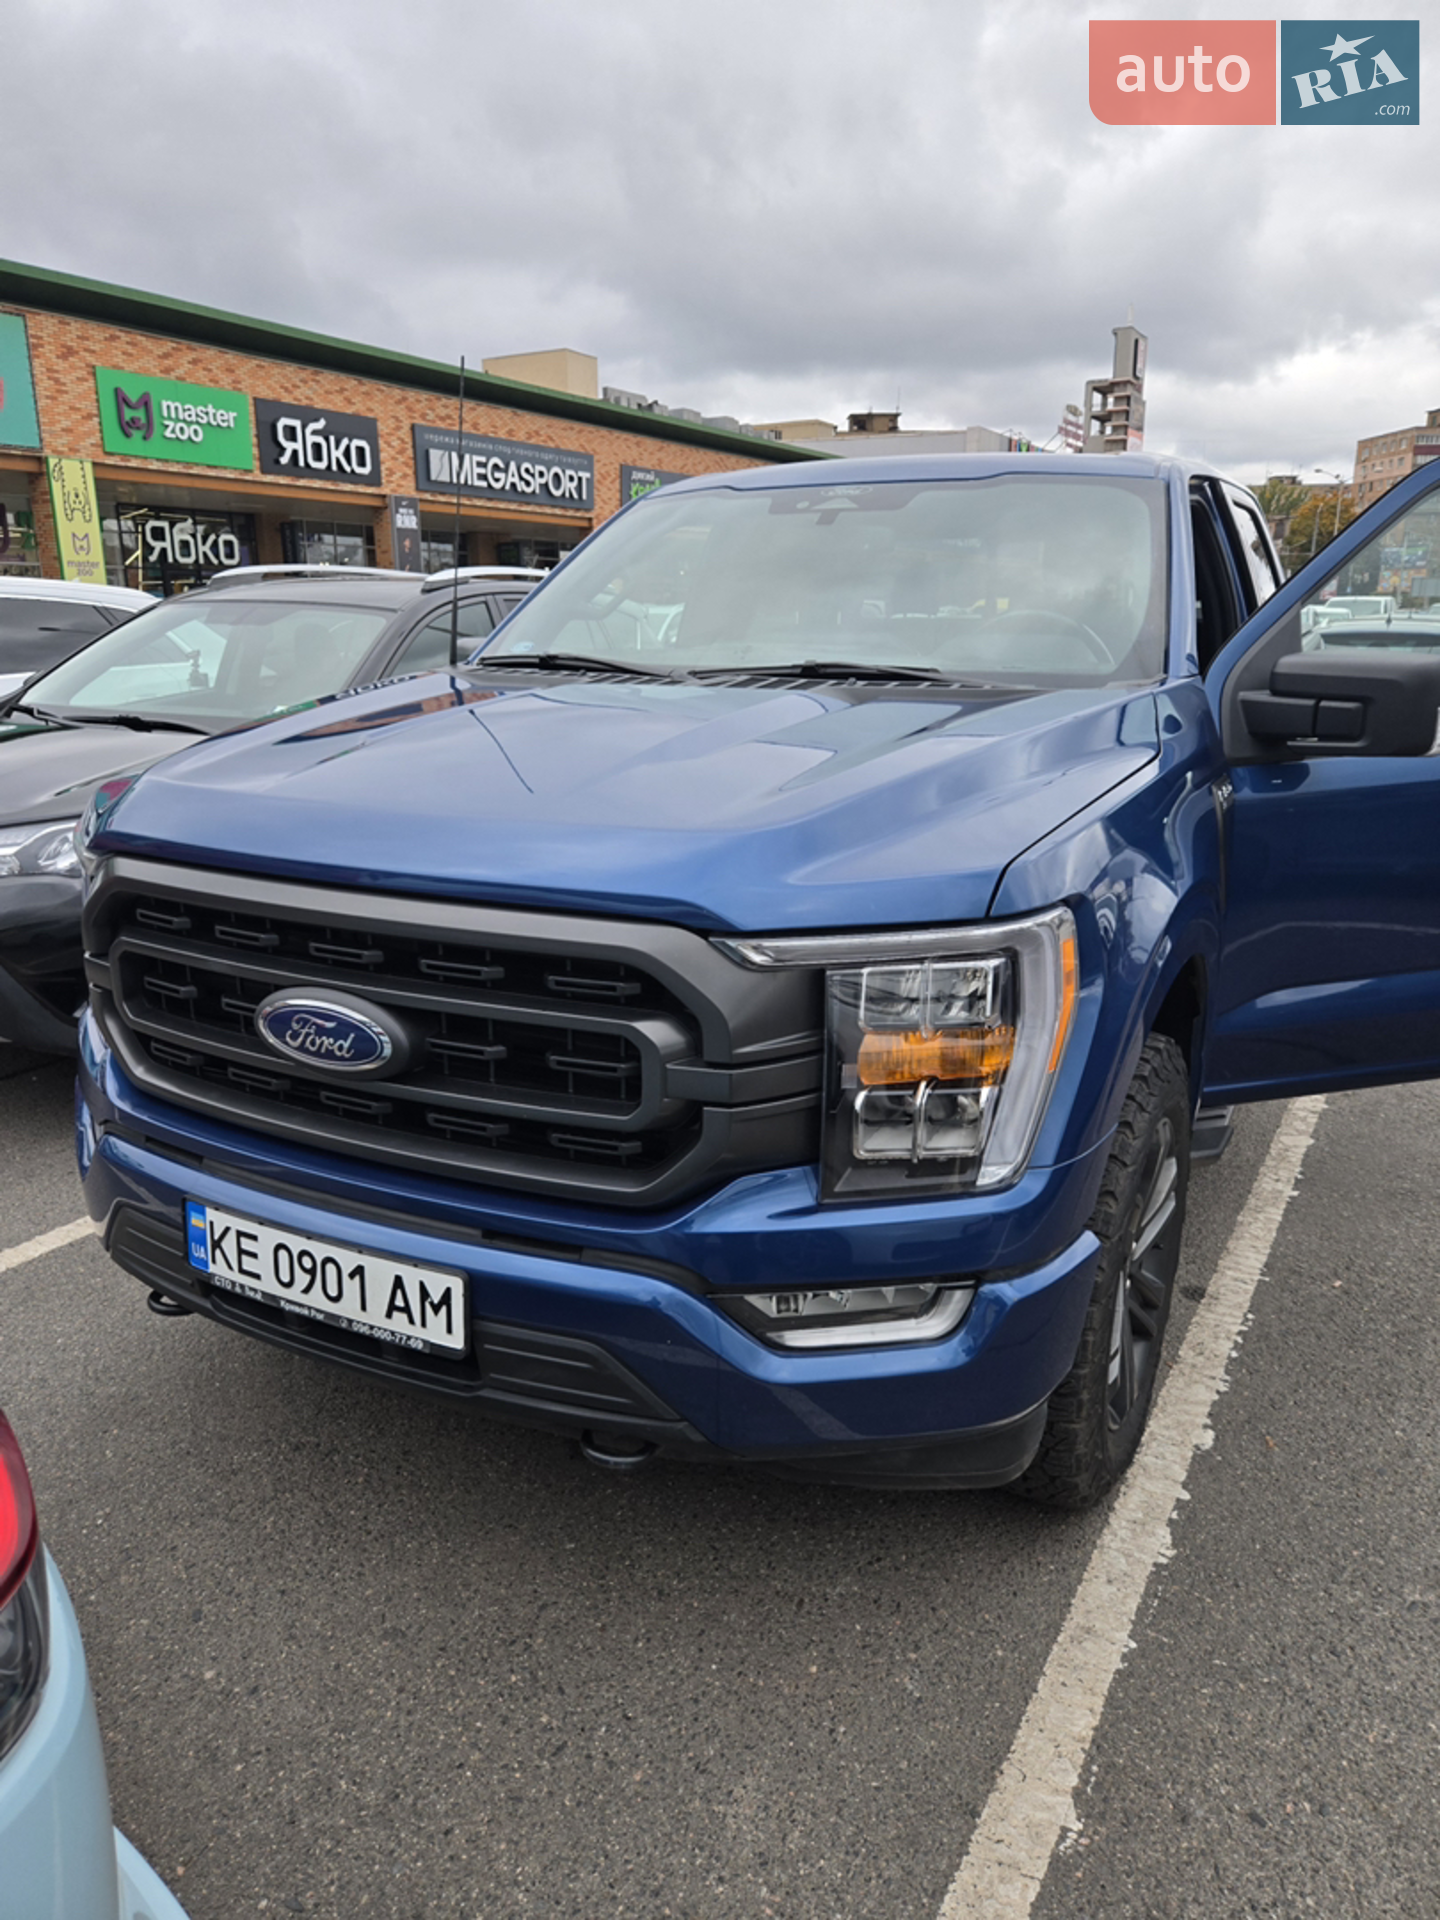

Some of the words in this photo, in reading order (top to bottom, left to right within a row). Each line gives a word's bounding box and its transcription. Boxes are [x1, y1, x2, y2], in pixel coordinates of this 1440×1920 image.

[161, 399, 237, 428] master
[163, 420, 204, 443] zoo
[451, 450, 591, 501] MEGASPORT
[67, 560, 100, 570] master
[77, 567, 94, 576] zoo
[285, 1013, 356, 1059] Ford
[191, 1241, 207, 1261] UA
[209, 1219, 262, 1281] KE
[273, 1241, 367, 1313] 0901
[384, 1273, 453, 1336] AM
